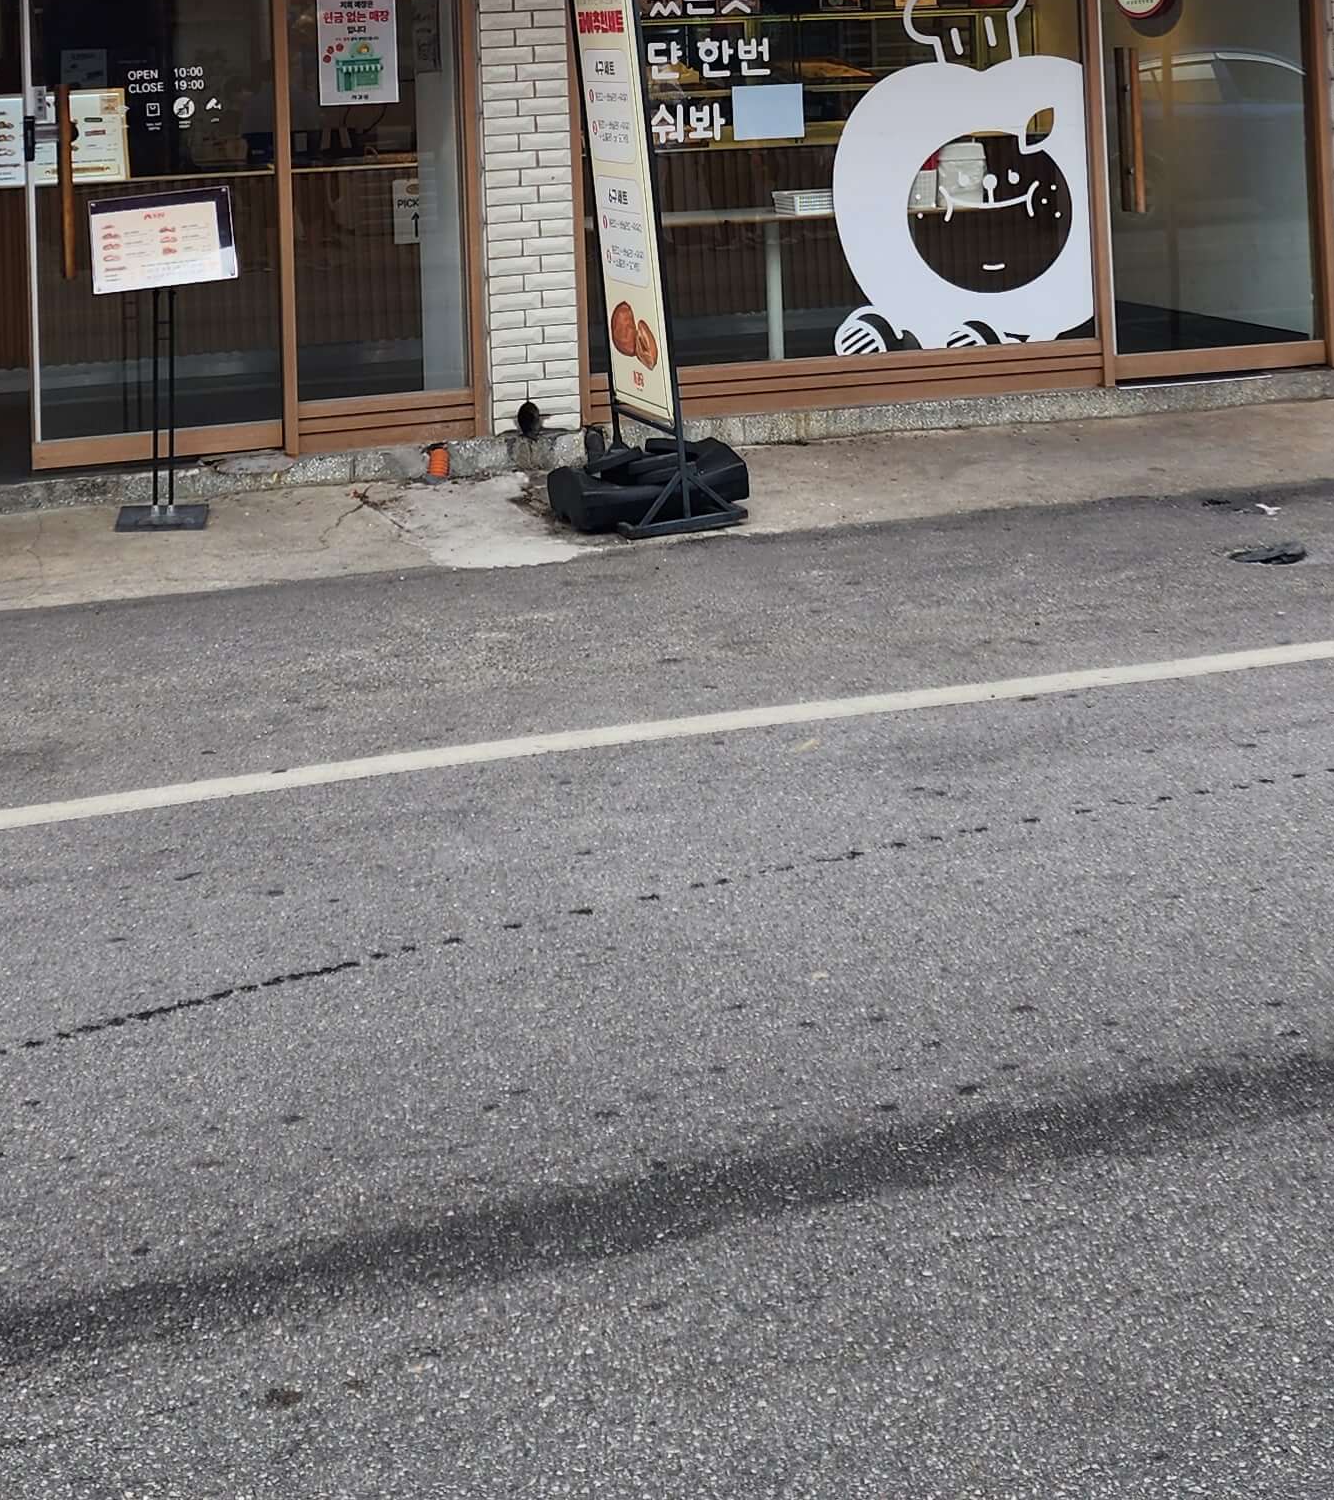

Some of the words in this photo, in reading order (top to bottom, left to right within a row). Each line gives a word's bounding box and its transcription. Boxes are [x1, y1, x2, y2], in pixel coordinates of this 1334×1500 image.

[697, 37, 771, 78] 한번
[127, 69, 159, 81] OPEN
[173, 66, 204, 78] 10:00
[128, 82, 165, 94] CLOSE
[174, 79, 205, 90] 19:00
